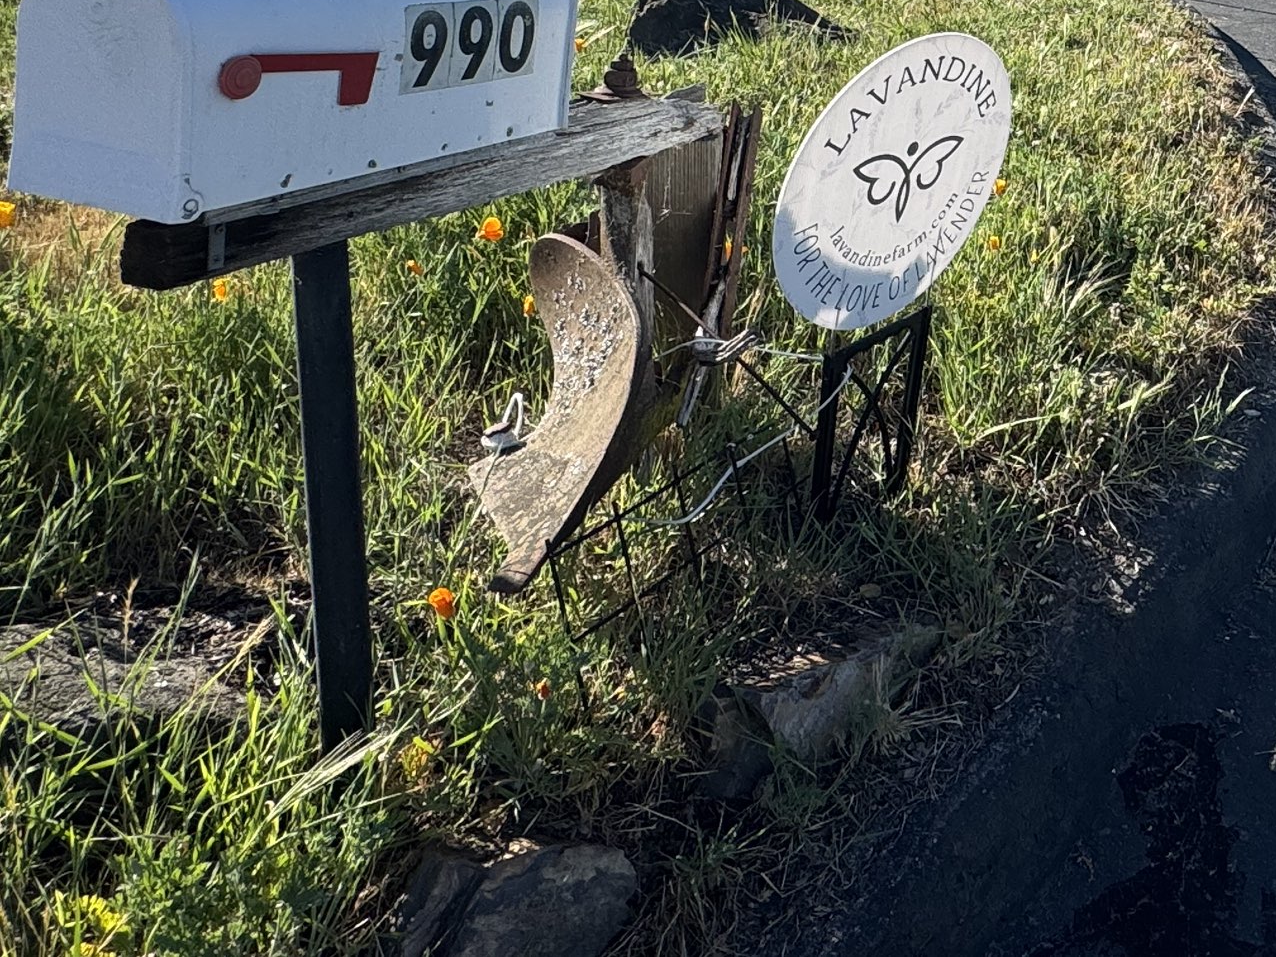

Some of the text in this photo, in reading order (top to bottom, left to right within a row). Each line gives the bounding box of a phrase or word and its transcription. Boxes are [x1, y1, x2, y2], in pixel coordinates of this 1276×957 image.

[410, 0, 535, 88] 990
[825, 55, 996, 156] LAVANDINE
[793, 170, 990, 313] FOR THE LOVE OF LAVENDER
[829, 191, 959, 268] lavandinefarm.com
